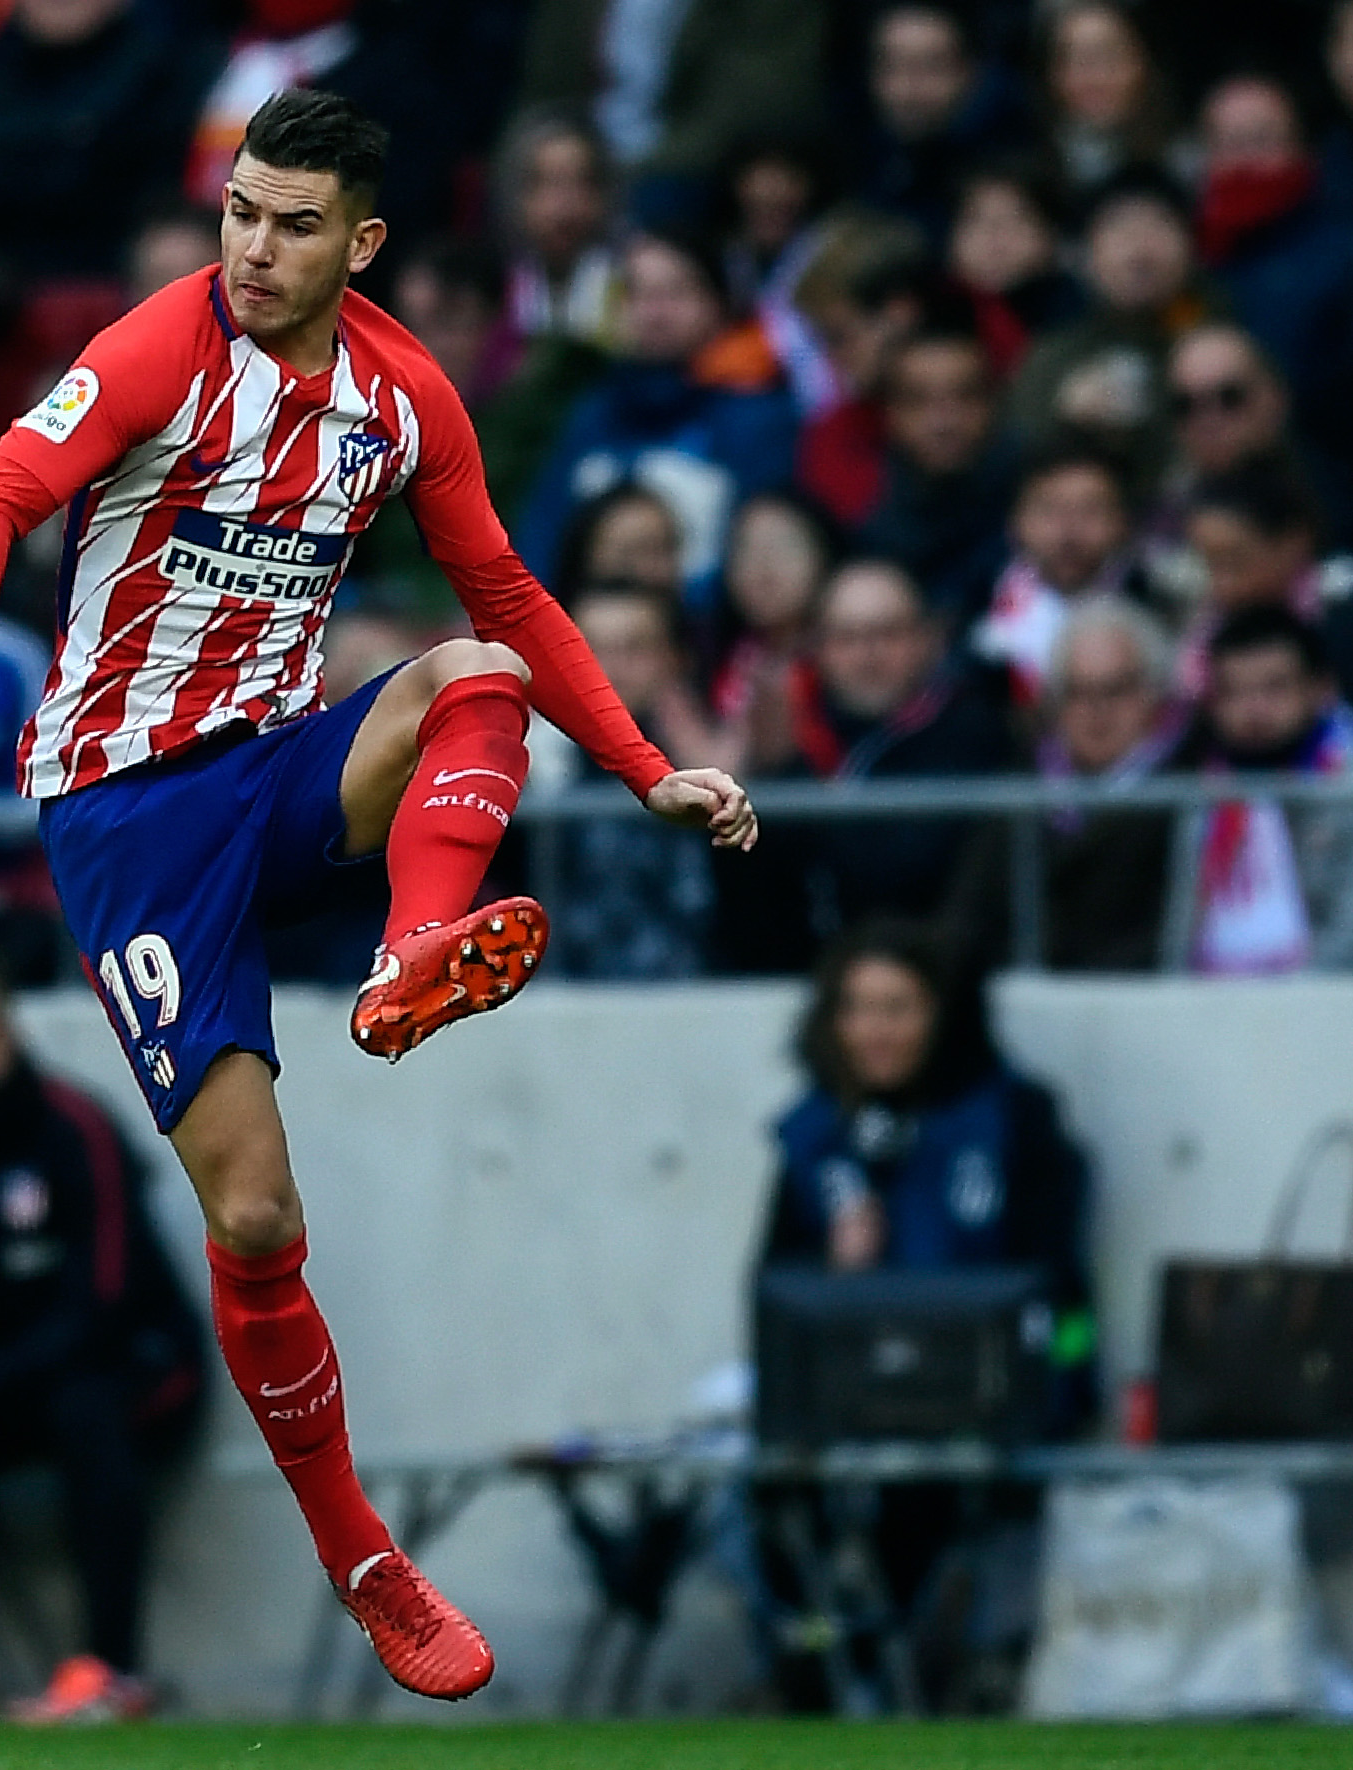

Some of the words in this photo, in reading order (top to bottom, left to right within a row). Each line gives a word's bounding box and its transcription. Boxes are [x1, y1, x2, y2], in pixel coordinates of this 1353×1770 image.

[219, 520, 318, 563] Trade
[164, 545, 330, 600] Plus500
[99, 933, 181, 1040] 19
